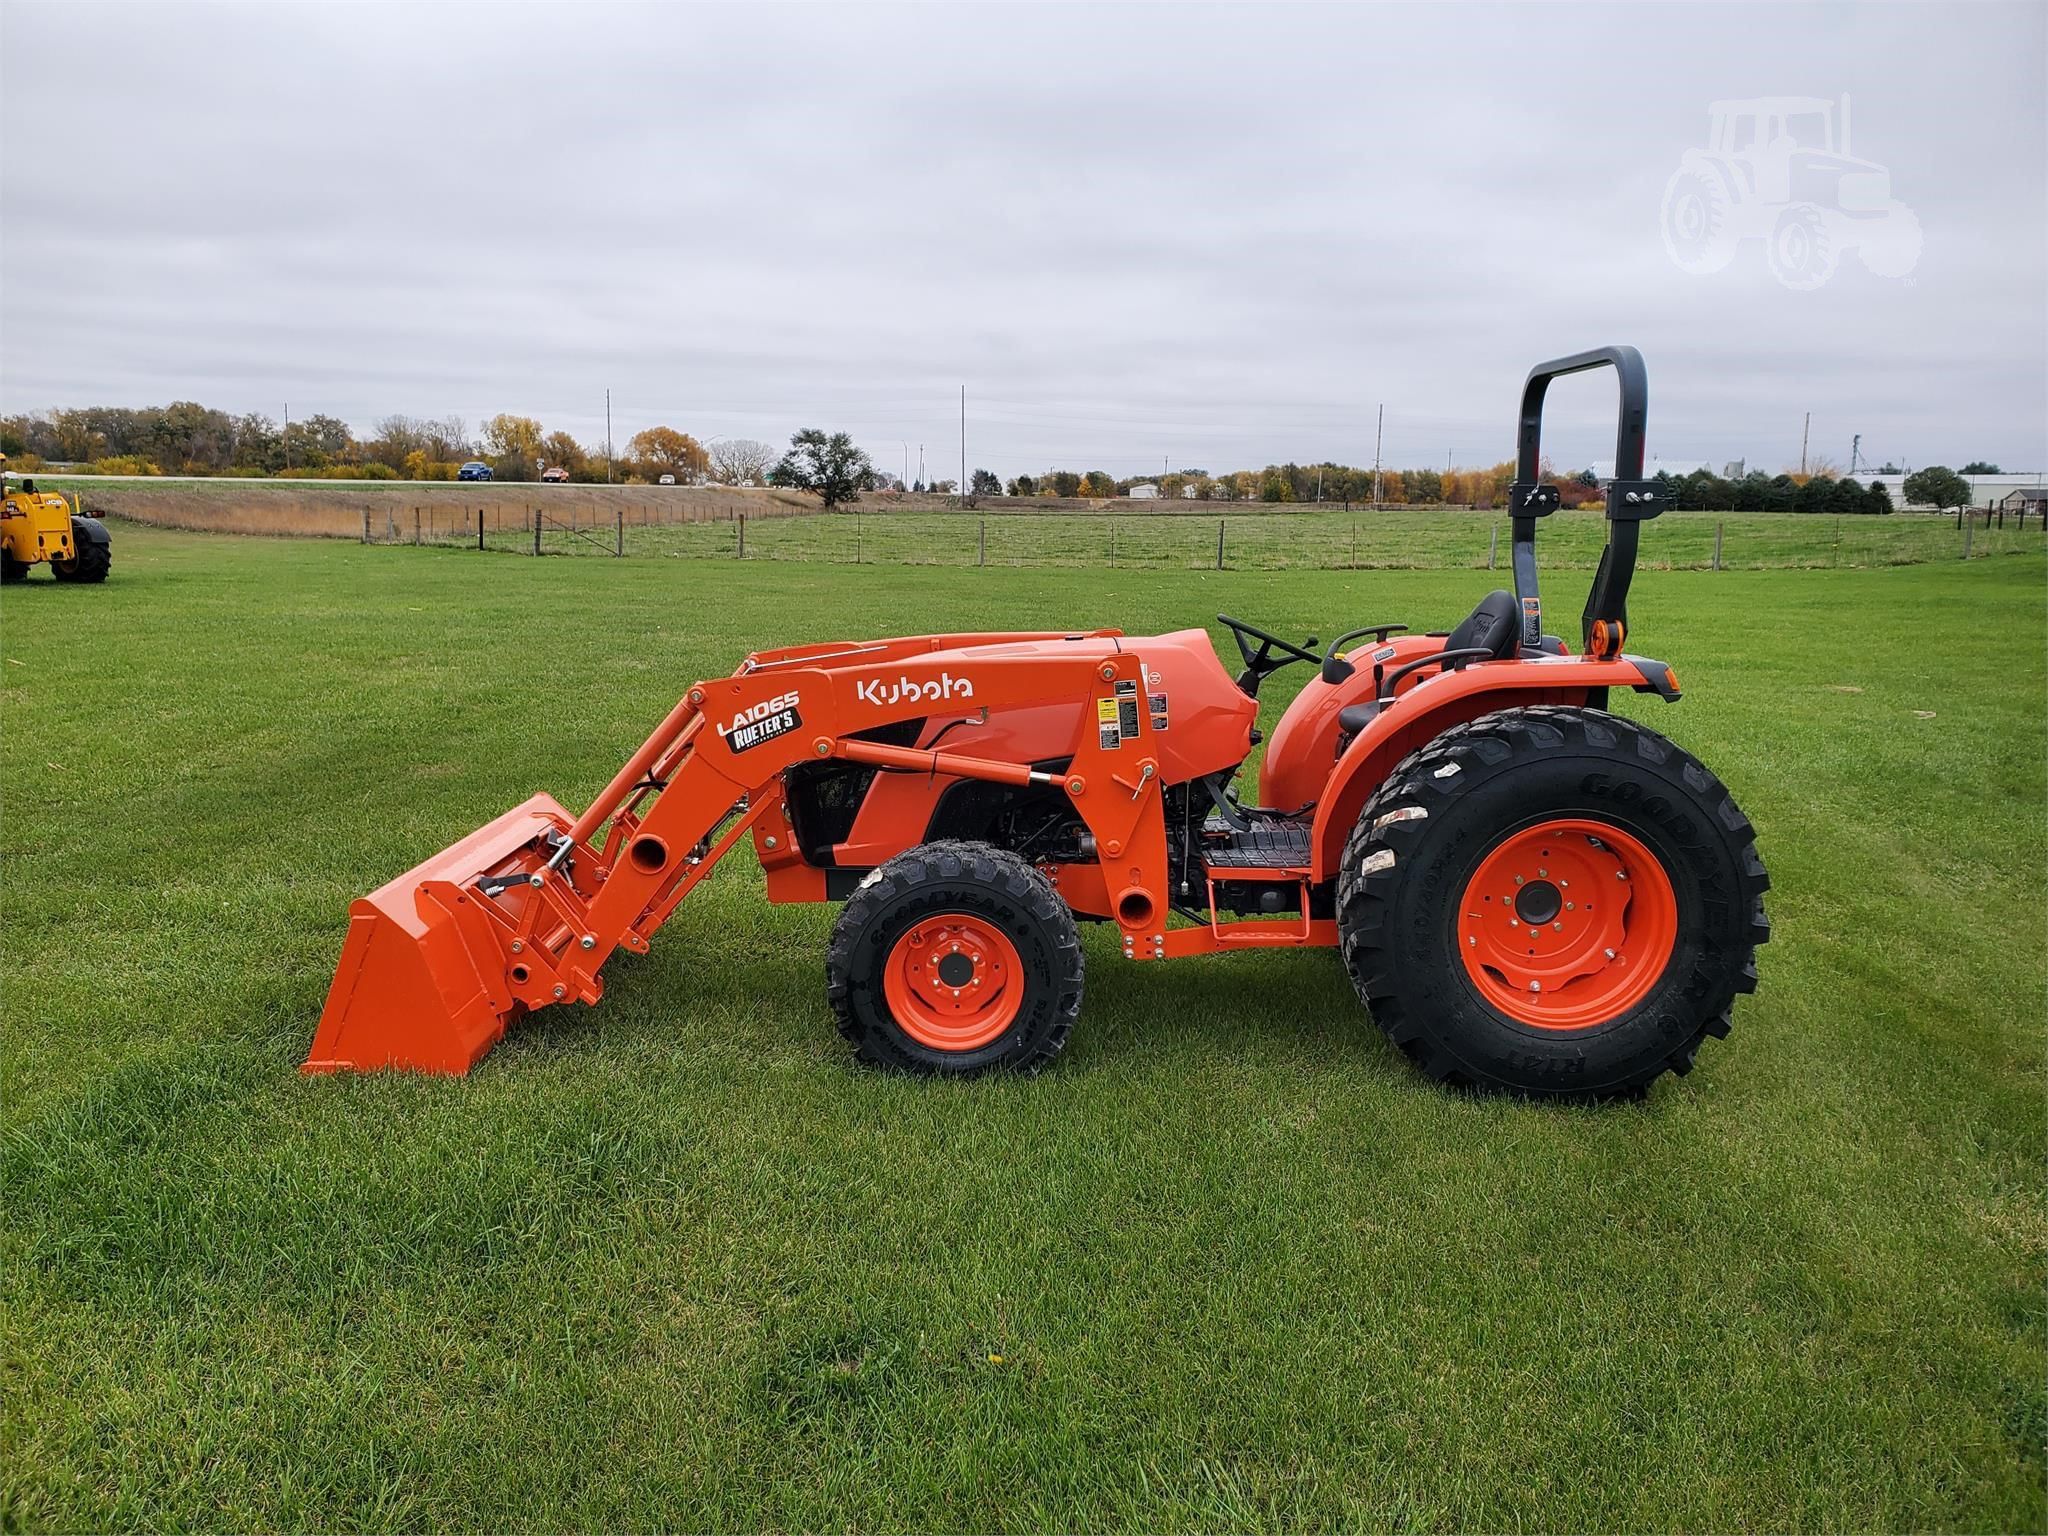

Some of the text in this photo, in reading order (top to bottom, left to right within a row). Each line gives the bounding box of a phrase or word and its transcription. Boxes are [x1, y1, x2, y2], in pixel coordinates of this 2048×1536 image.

[857, 673, 973, 705] Kubota
[716, 690, 800, 737] LA1065
[733, 710, 794, 749] RUETER'S
